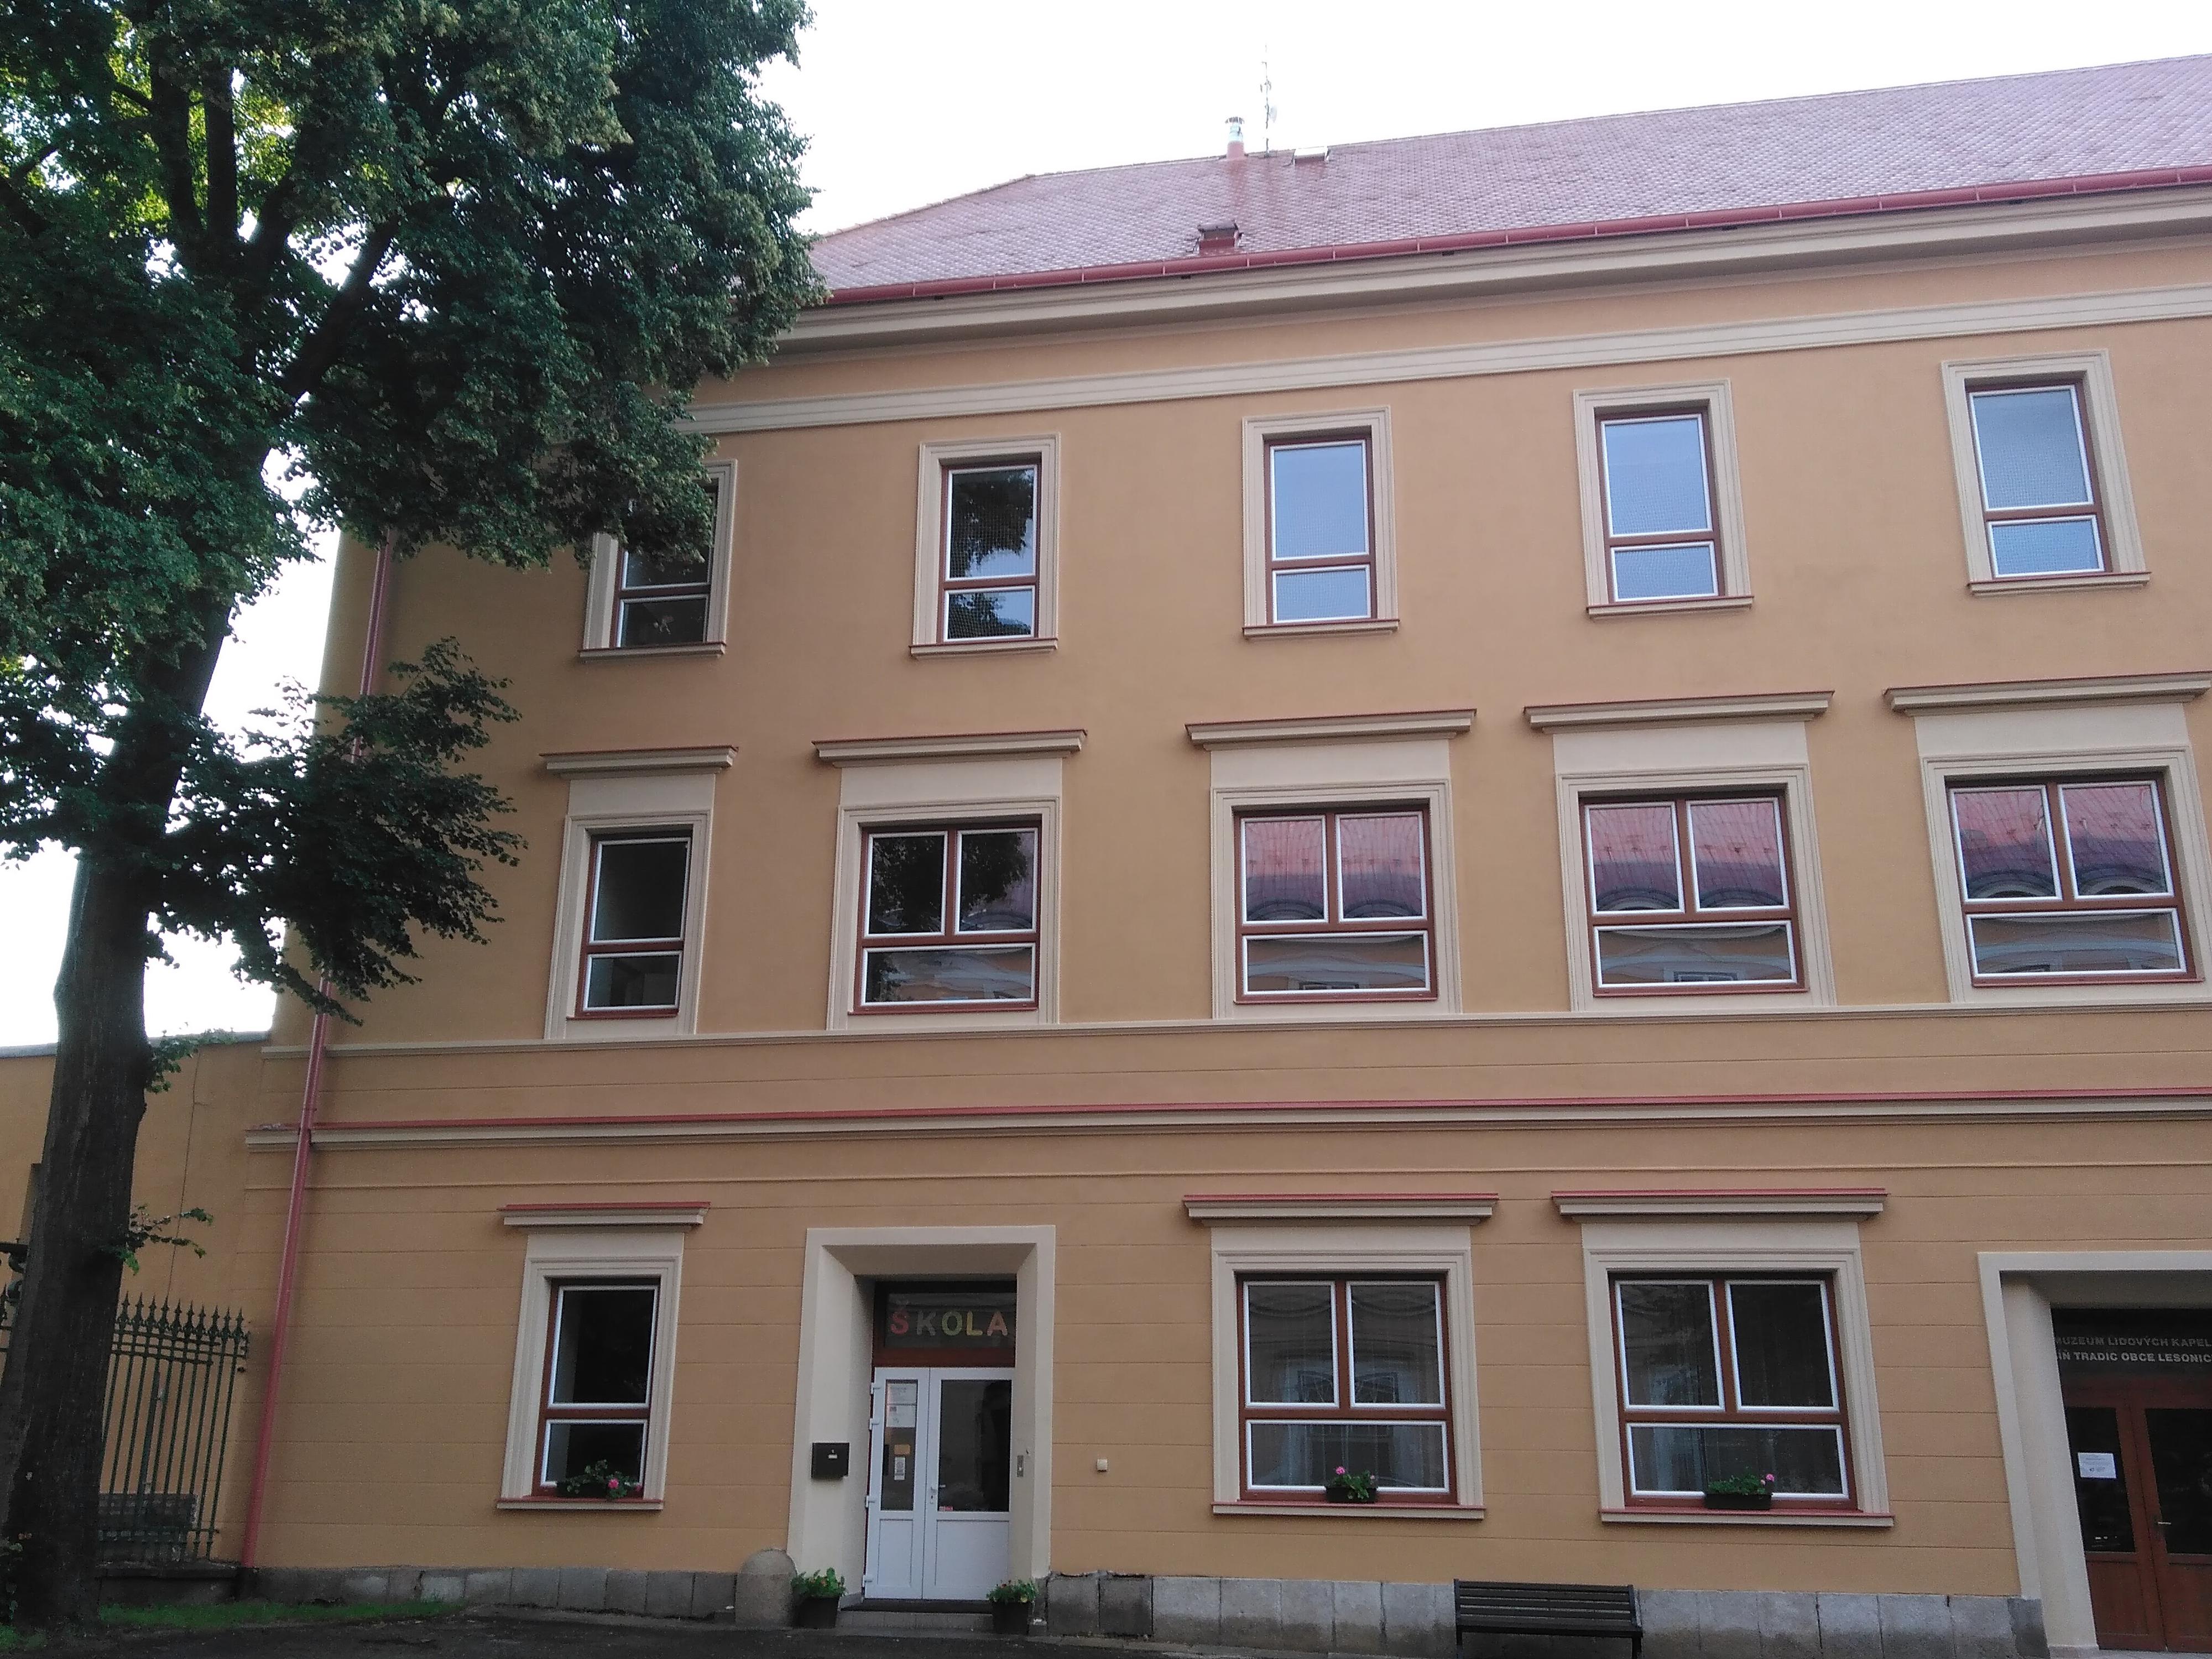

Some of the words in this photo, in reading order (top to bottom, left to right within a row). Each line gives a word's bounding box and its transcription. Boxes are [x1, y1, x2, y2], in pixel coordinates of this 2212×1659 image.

[890, 1301, 1008, 1336] ŠKOLA
[2107, 1336, 2168, 1346] LIDOVÝCH
[2172, 1338, 2212, 1347] KAPEL
[2073, 1352, 2118, 1361] TRADIC
[2120, 1352, 2156, 1361] OBCE
[2158, 1353, 2212, 1363] LESONIC
